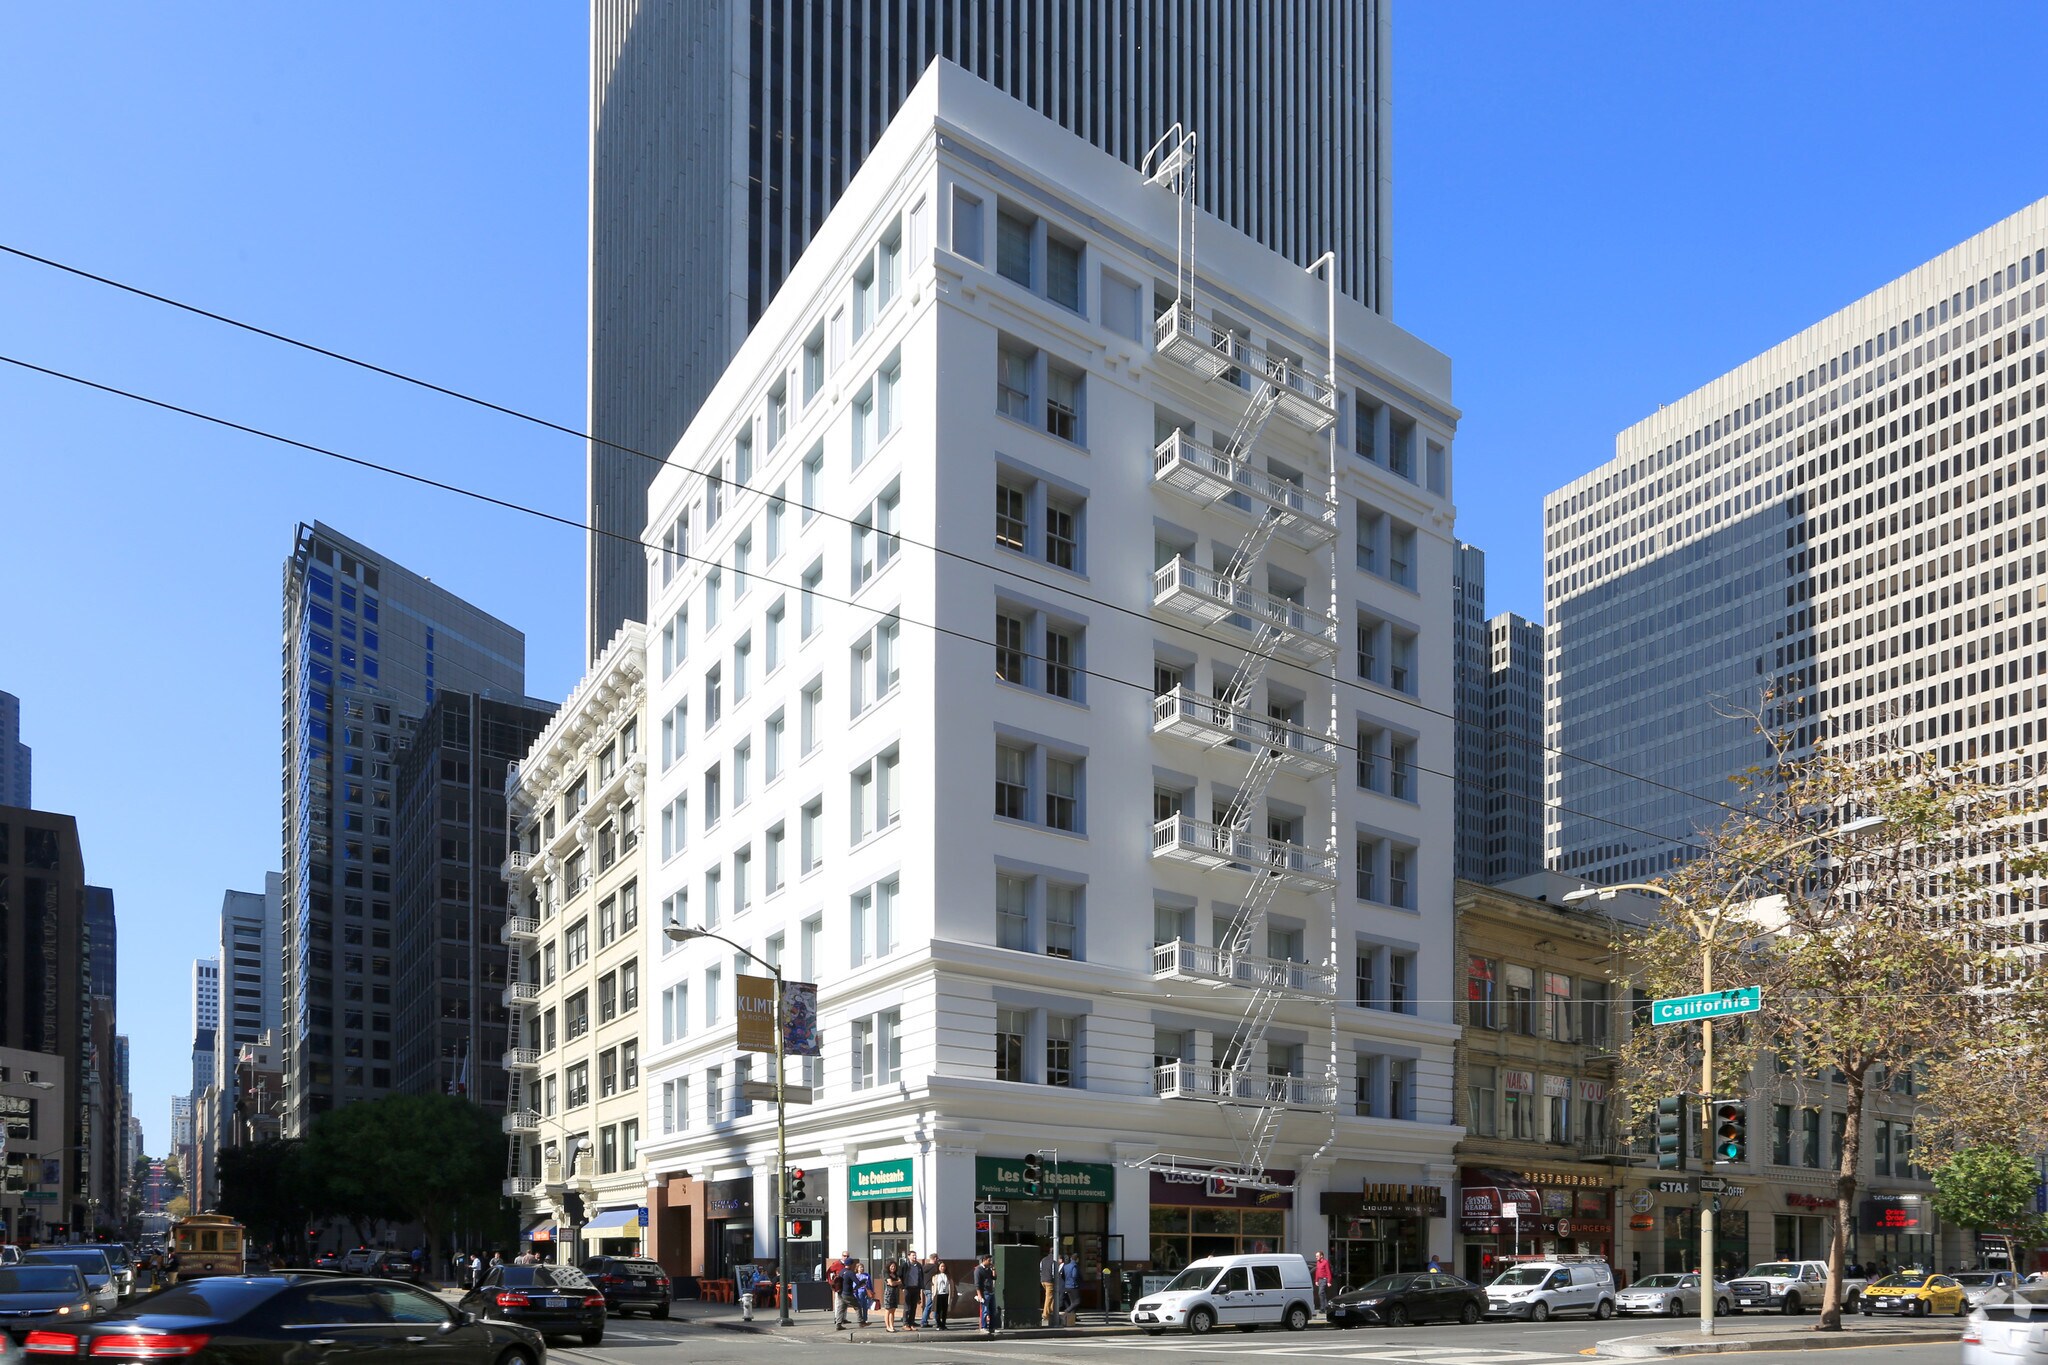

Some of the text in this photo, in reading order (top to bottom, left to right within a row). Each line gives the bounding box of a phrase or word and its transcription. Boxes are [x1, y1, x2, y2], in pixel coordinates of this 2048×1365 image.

[738, 995, 773, 1014] KLIMT
[1661, 996, 1751, 1018] California
[1507, 1071, 1529, 1090] NAILS
[1546, 1076, 1565, 1087] FOR
[1580, 1081, 1604, 1100] YOU
[858, 1168, 905, 1185] Les Croissants
[997, 1167, 1020, 1182] Les
[1163, 1171, 1205, 1184] TACO
[1524, 1172, 1604, 1187] RESTAURANT
[1077, 1189, 1106, 1197] SANDWICHES
[1363, 1184, 1407, 1202] DRUMM
[1465, 1195, 1491, 1205] CRYSTAL
[790, 1207, 823, 1215] DRUMM
[1464, 1202, 1493, 1211] READER
[1560, 1222, 1569, 1233] Z
[1571, 1225, 1613, 1233] BURGERS
